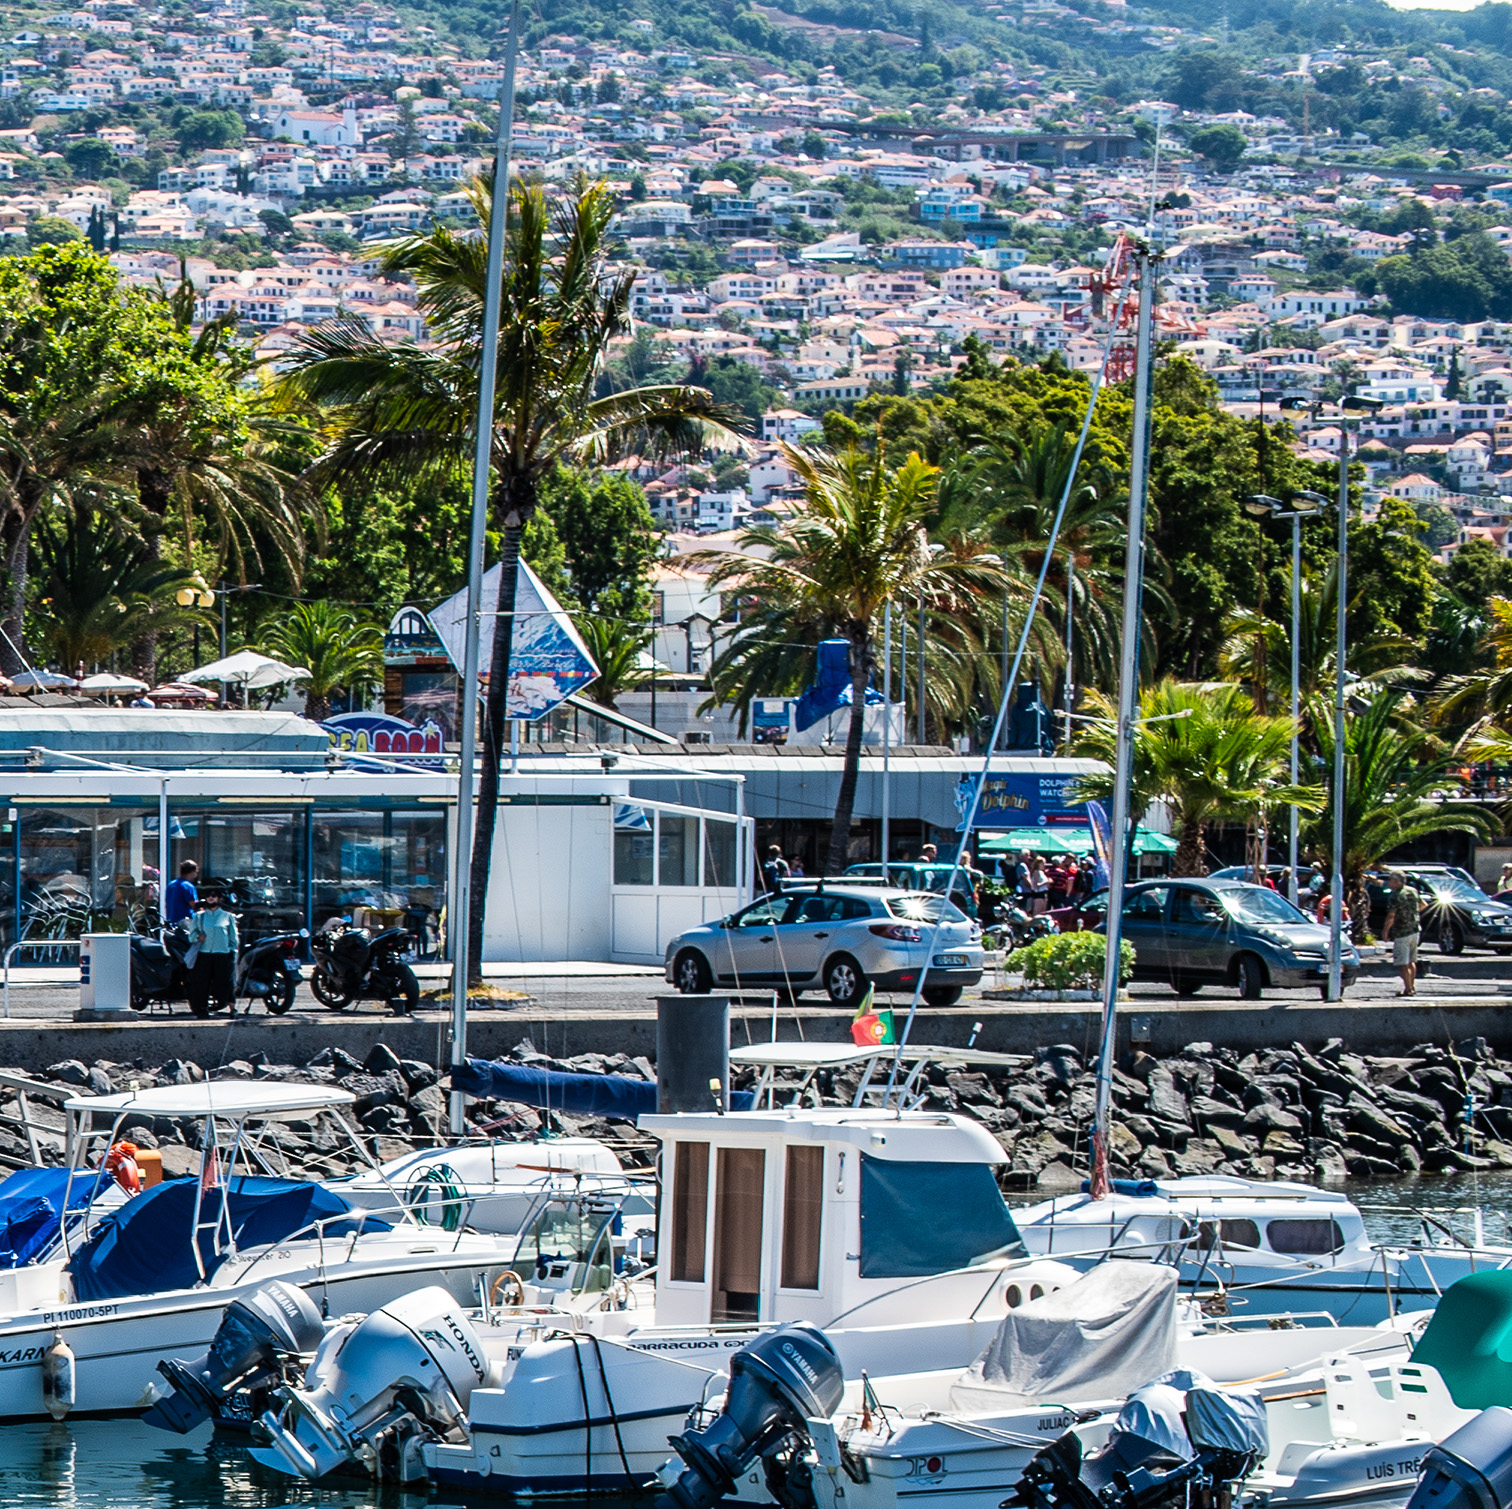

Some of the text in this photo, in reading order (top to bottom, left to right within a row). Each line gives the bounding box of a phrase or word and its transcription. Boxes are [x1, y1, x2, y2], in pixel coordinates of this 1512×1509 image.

[375, 731, 442, 761] BORN
[1039, 779, 1075, 788] DOLPHIN
[982, 792, 1030, 811] Dolphin
[278, 1251, 292, 1260] 210
[267, 1285, 299, 1318] YAMAHA
[442, 1314, 486, 1385] HONDA
[791, 1349, 819, 1385] YAMAHA
[1037, 1418, 1069, 1431] JULIAC
[1366, 1460, 1395, 1480] LUÍS
